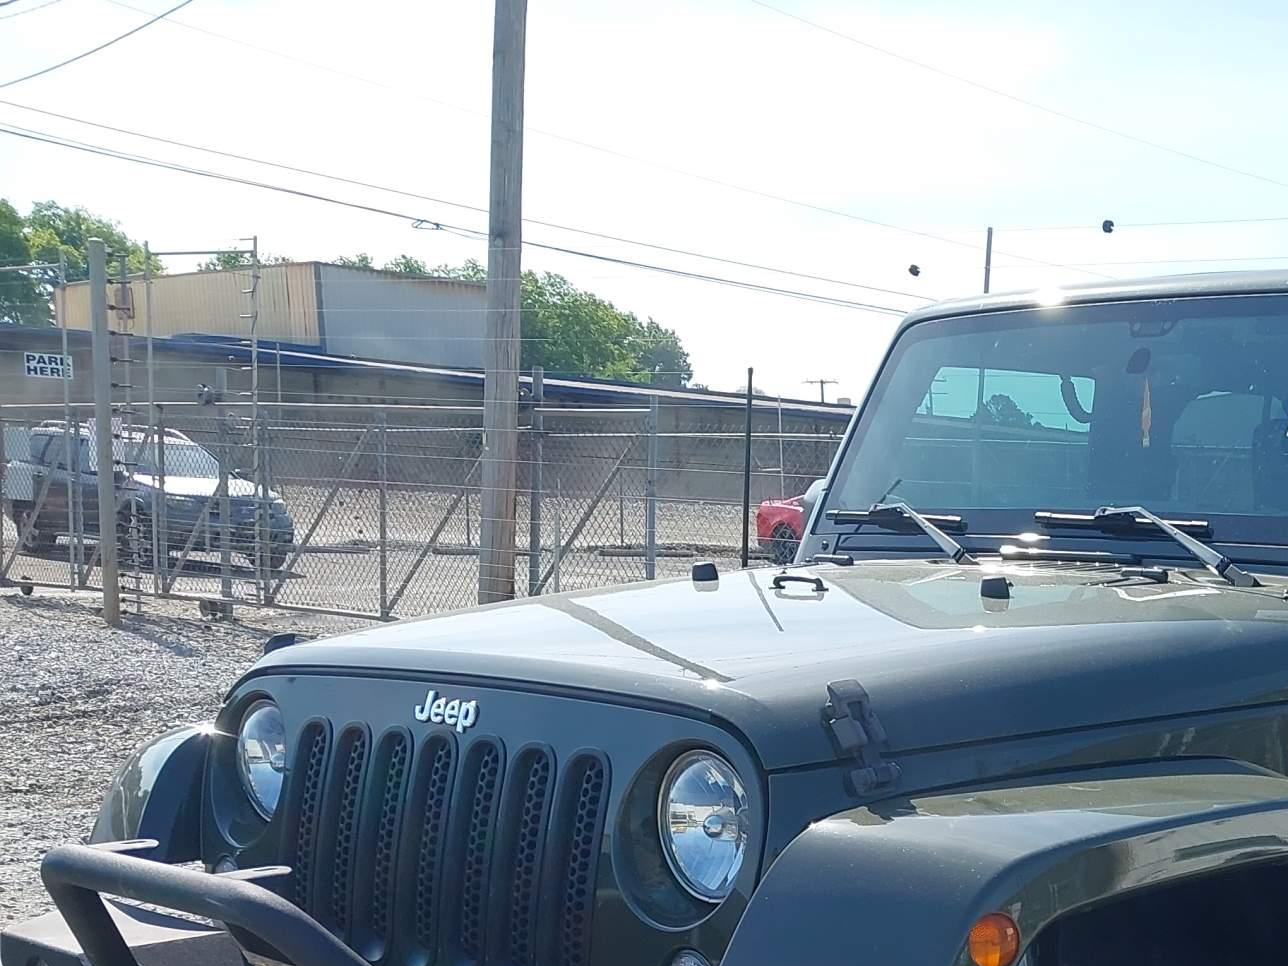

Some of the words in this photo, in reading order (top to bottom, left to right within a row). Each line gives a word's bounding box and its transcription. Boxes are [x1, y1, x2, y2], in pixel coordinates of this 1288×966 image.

[26, 354, 71, 367] PARK
[27, 365, 71, 378] HERE
[415, 690, 477, 733] Jeep
